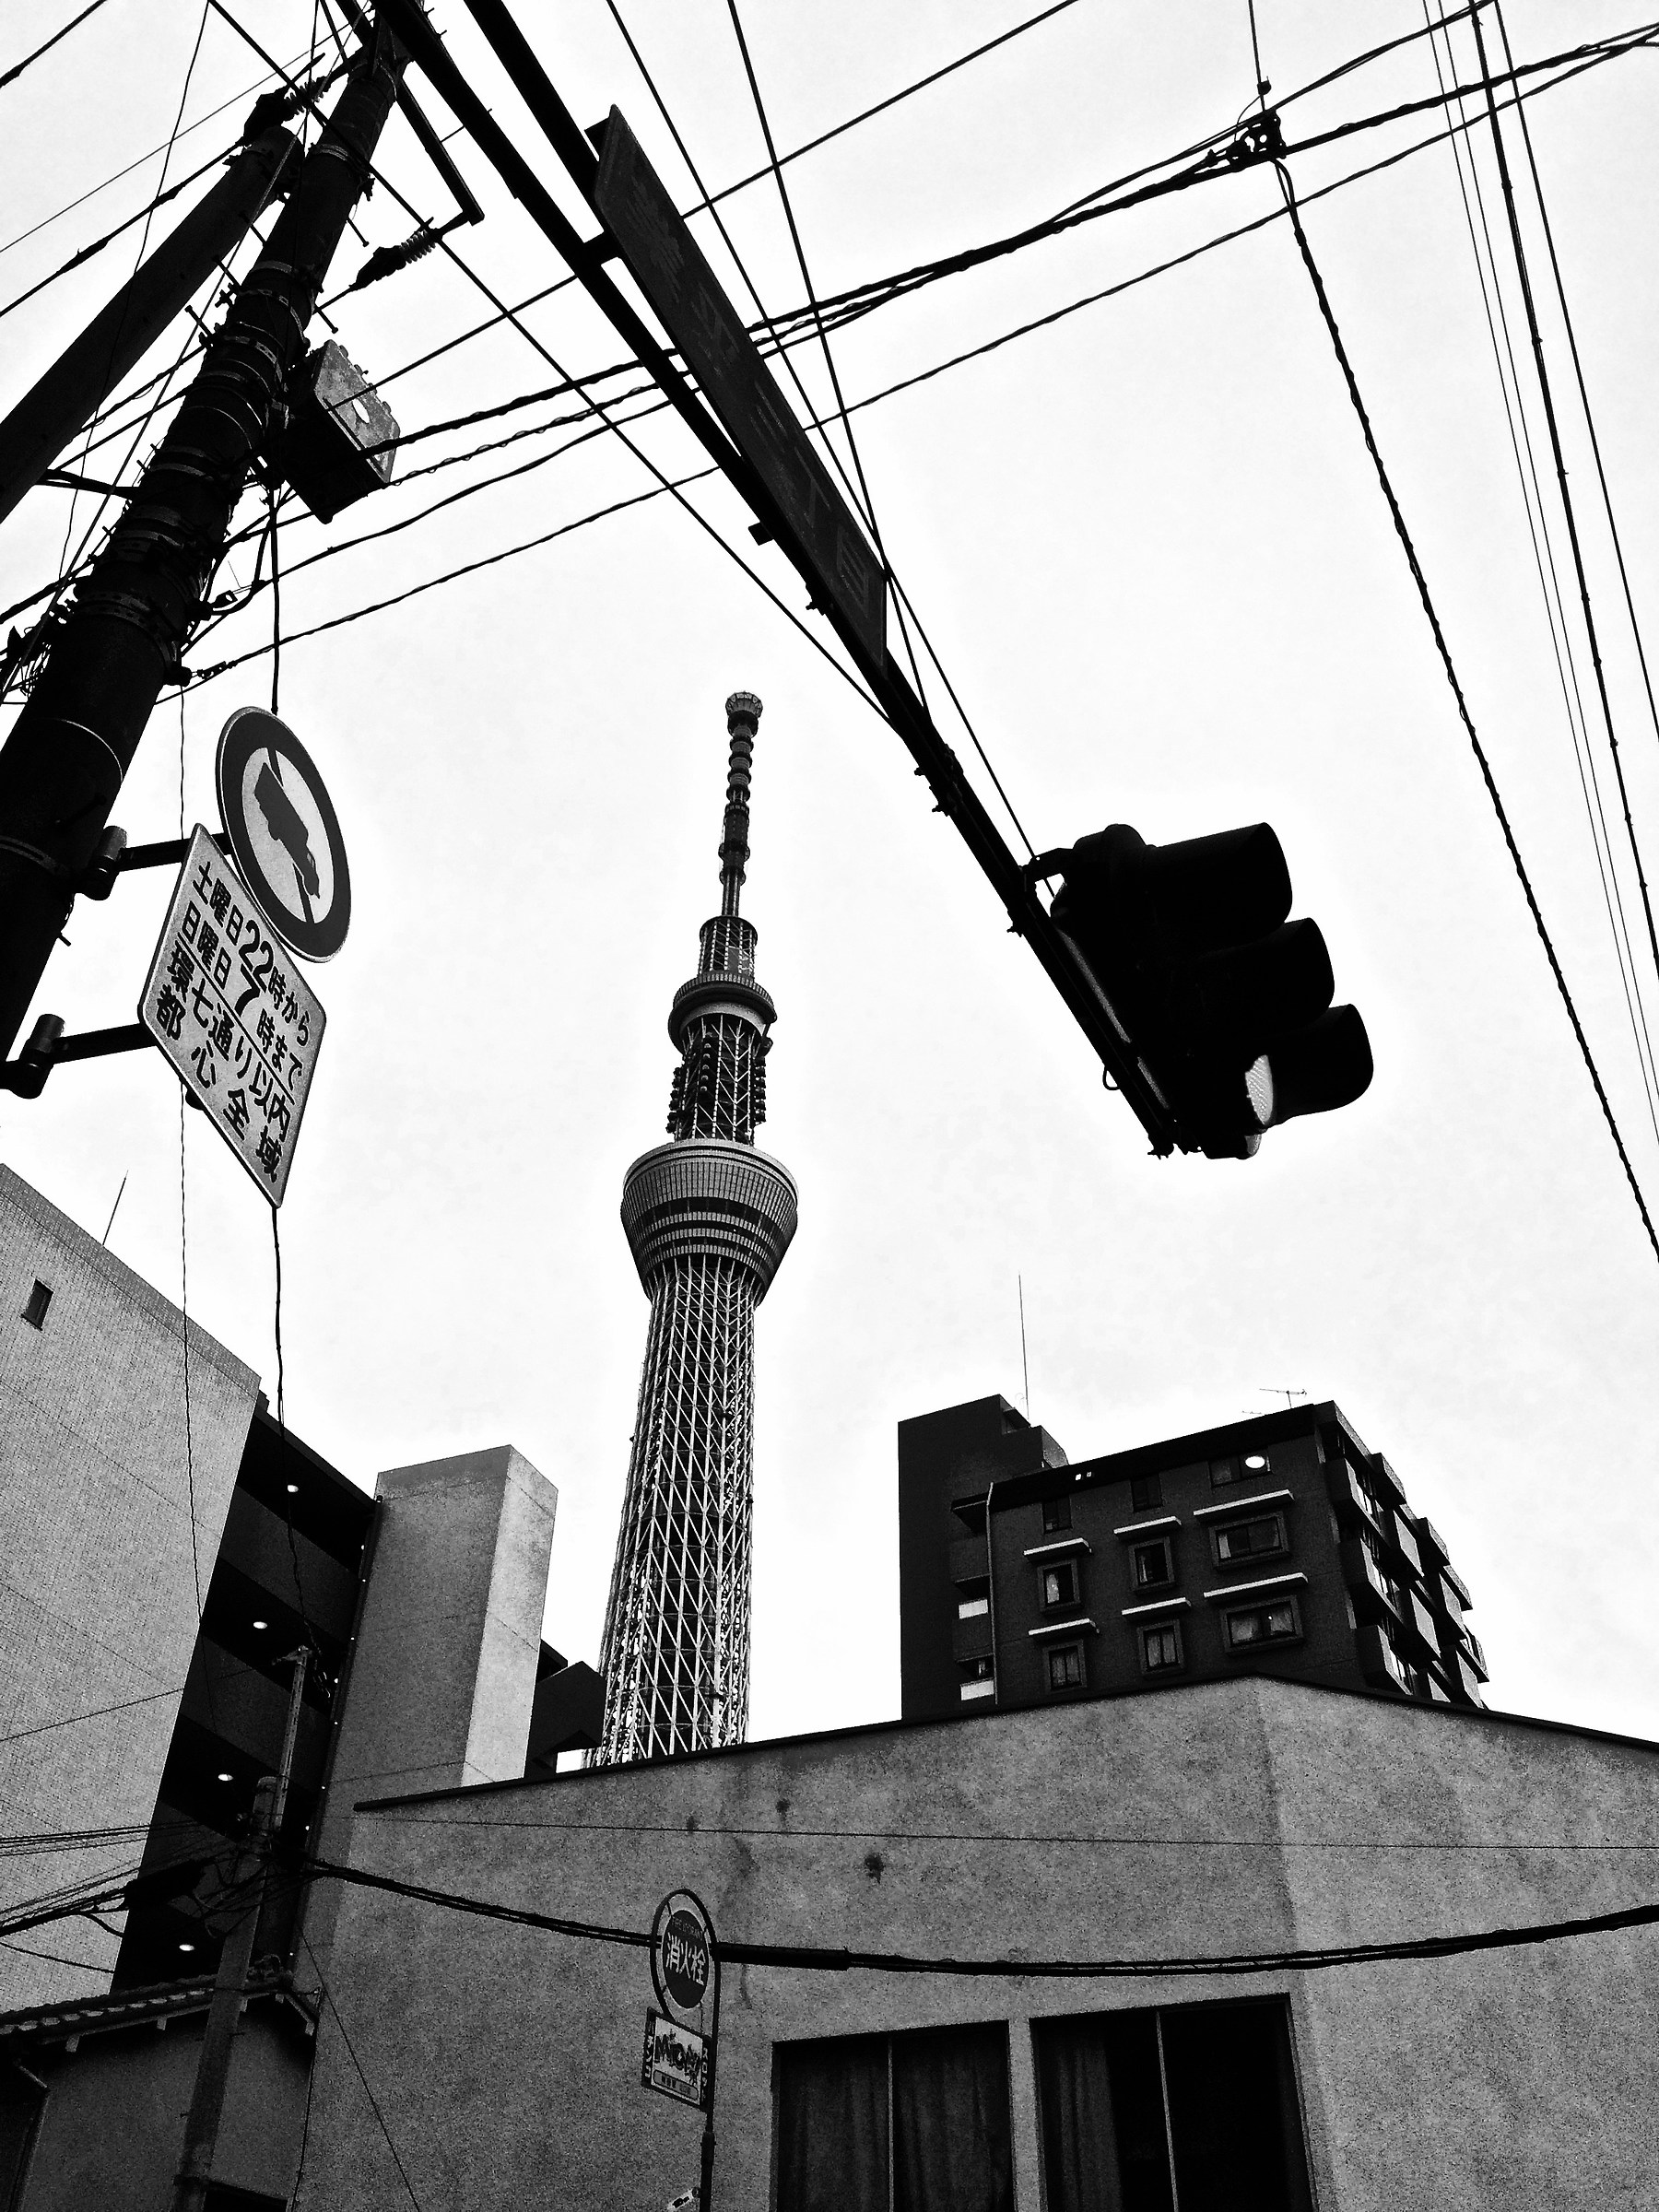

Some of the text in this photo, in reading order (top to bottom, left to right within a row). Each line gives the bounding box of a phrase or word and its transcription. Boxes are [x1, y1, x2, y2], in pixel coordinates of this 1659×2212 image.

[624, 173, 870, 618] 業平三丁目
[165, 939, 291, 1143] 環七通り以内
[181, 900, 303, 1091] 日曜日7時まで
[191, 861, 310, 1047] 土曜日22時から
[155, 982, 283, 1183] 都心全域
[665, 1932, 707, 1986] 消火栓
